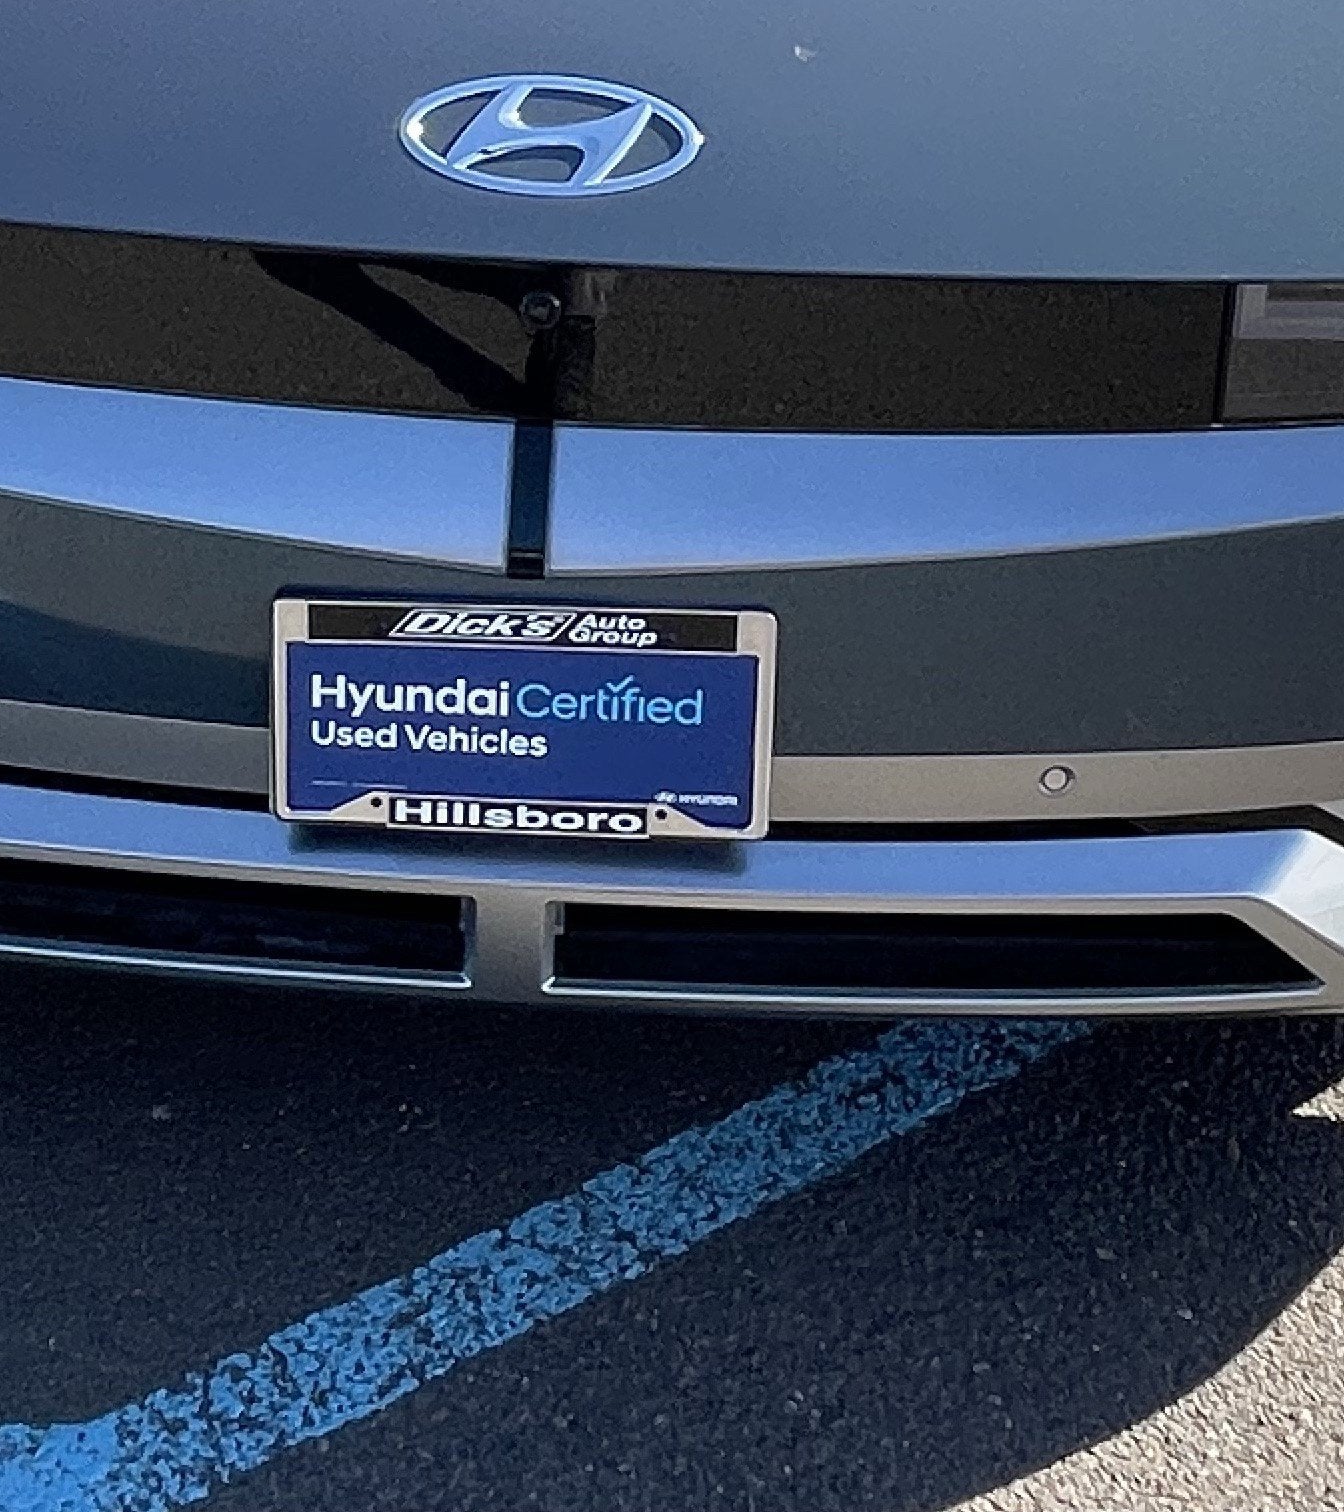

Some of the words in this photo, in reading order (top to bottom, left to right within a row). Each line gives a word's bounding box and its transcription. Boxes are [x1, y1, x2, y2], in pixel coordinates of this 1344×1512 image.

[404, 611, 559, 637] Dick's
[568, 625, 658, 648] Group
[579, 613, 648, 631] Auto
[311, 673, 510, 718] Hyundai
[516, 676, 703, 726] Certified
[311, 720, 398, 749] Used
[404, 723, 549, 757] Vehicles
[393, 798, 644, 833] Hillsboro
